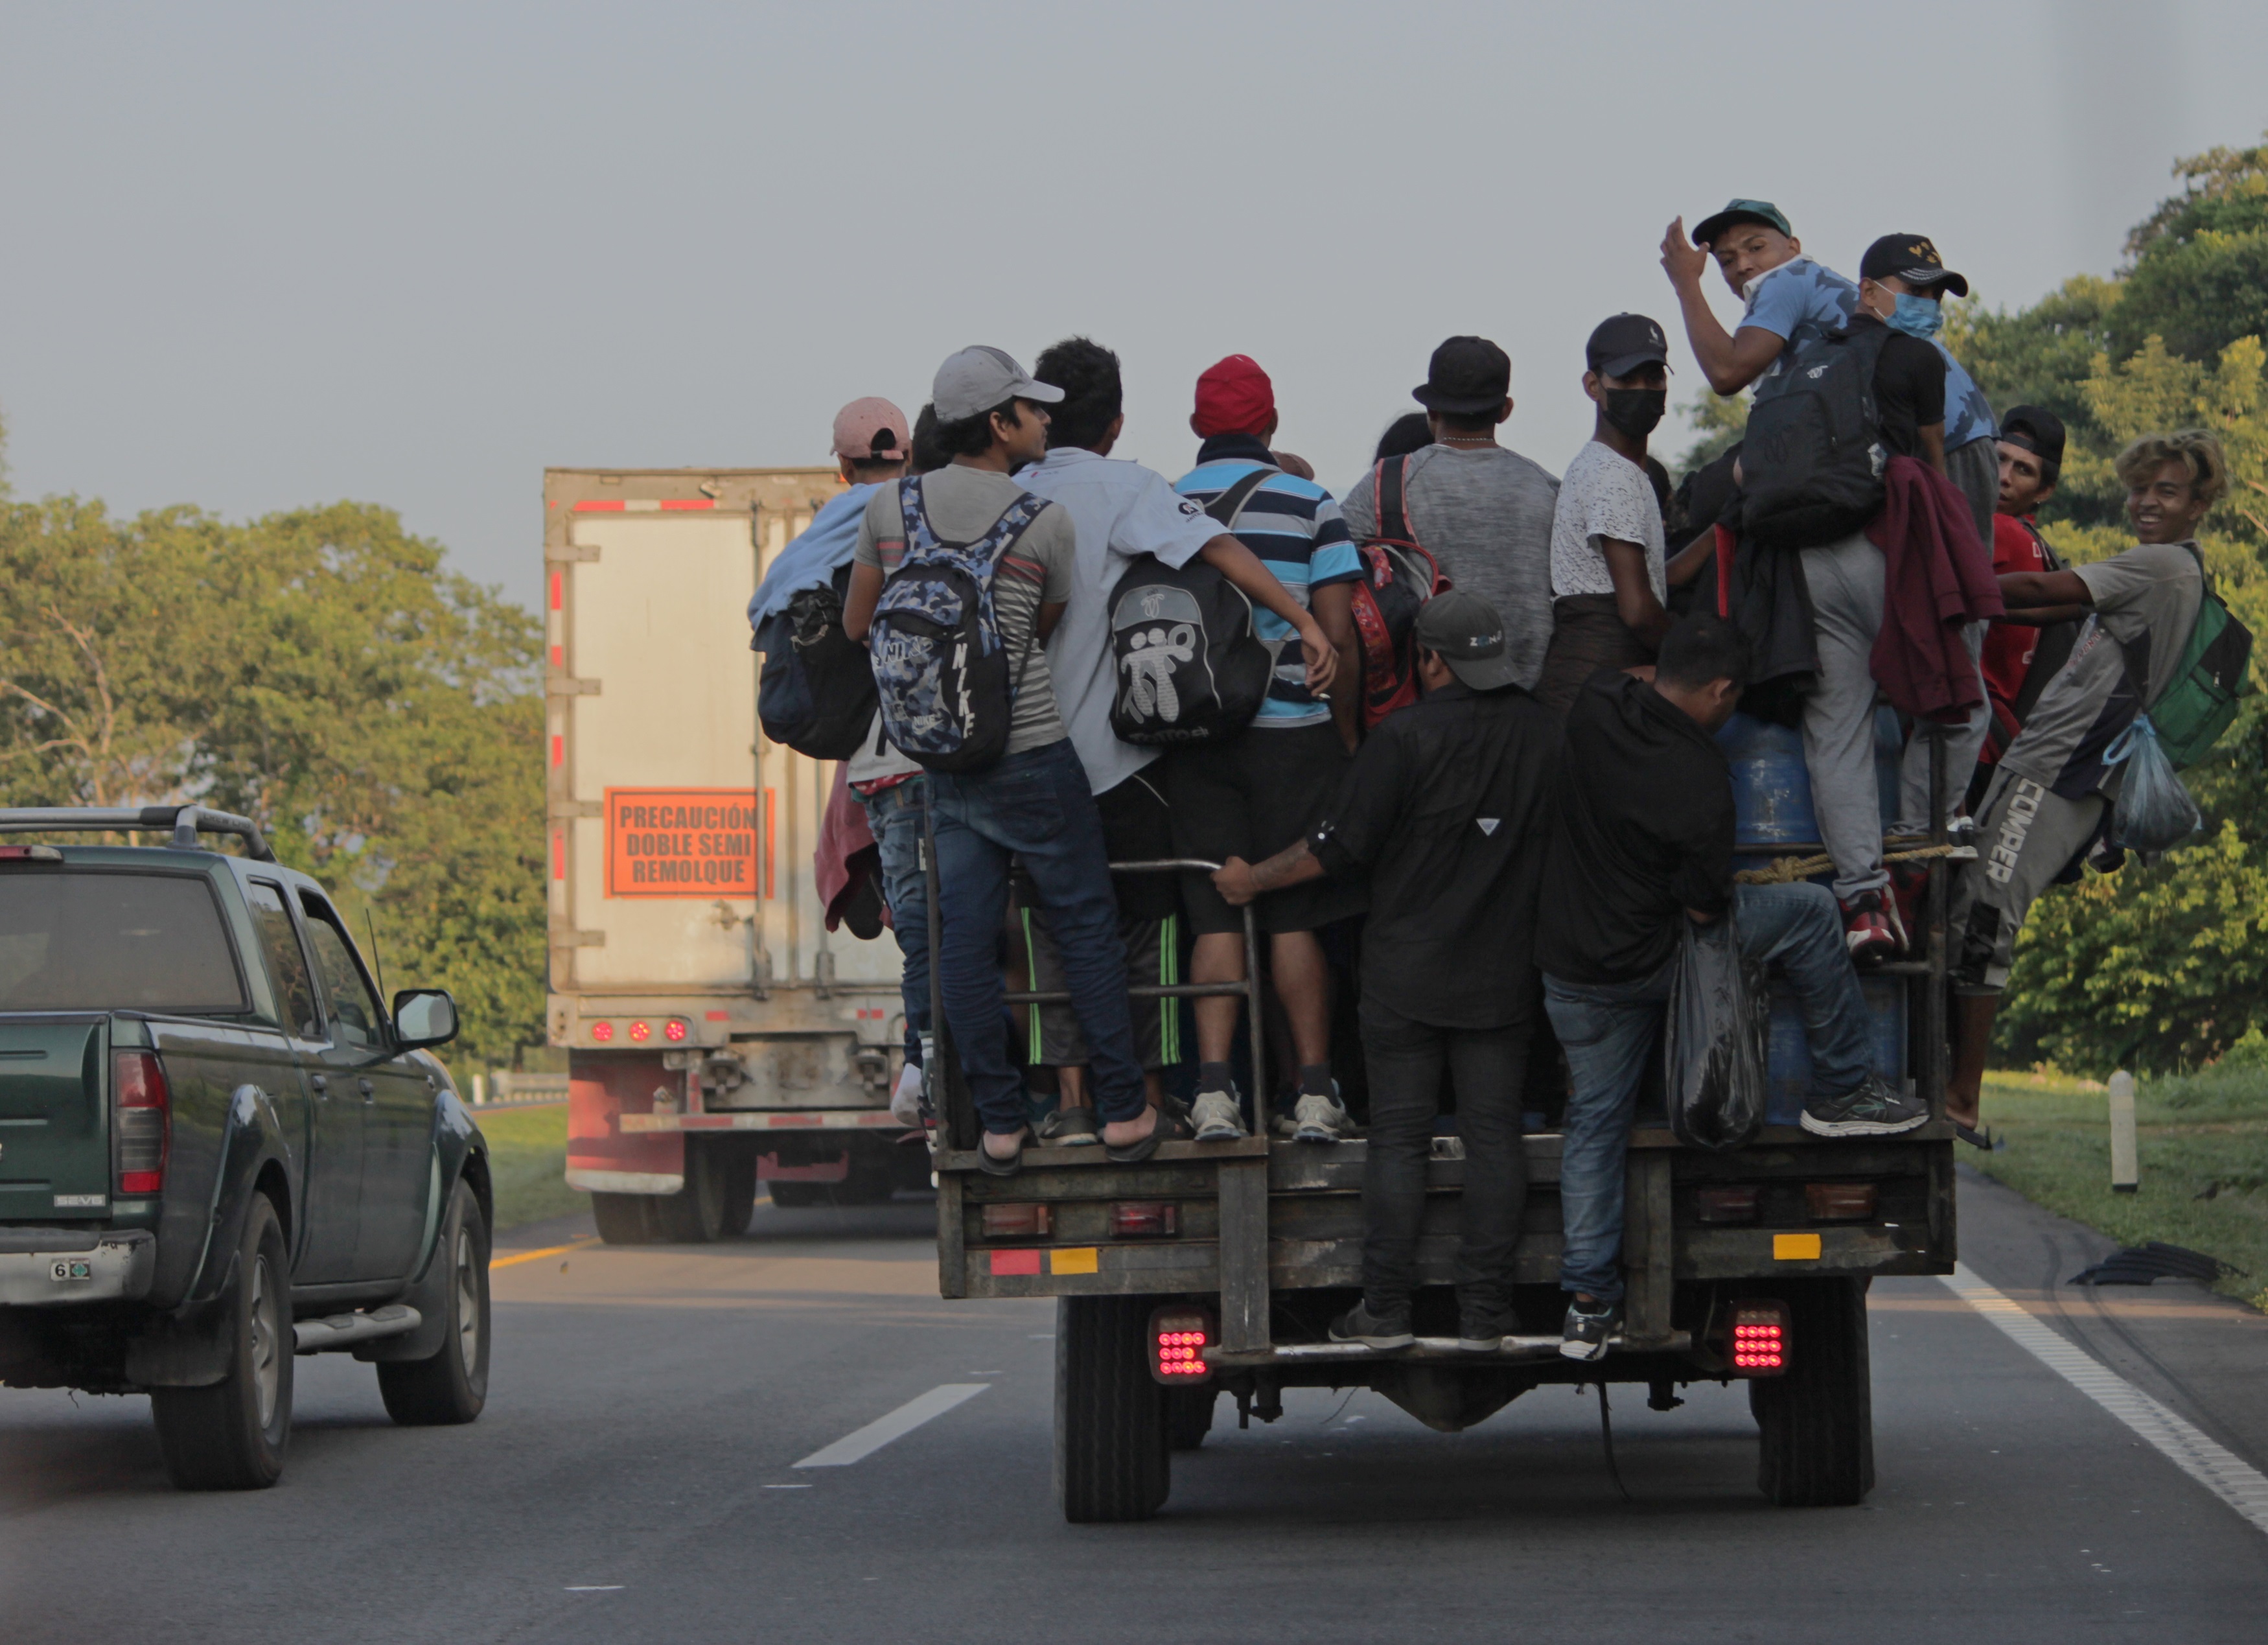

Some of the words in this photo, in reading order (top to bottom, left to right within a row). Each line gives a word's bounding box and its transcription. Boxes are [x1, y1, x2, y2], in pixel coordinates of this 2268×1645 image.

[913, 714, 936, 725] NIKE
[619, 802, 758, 830] PRECAUCIÓN
[1985, 778, 2046, 884] COMPER
[626, 833, 693, 857] DOBLE
[698, 833, 751, 857] SEMI
[632, 859, 745, 885] REMOLQUE
[54, 1264, 66, 1278] 6
